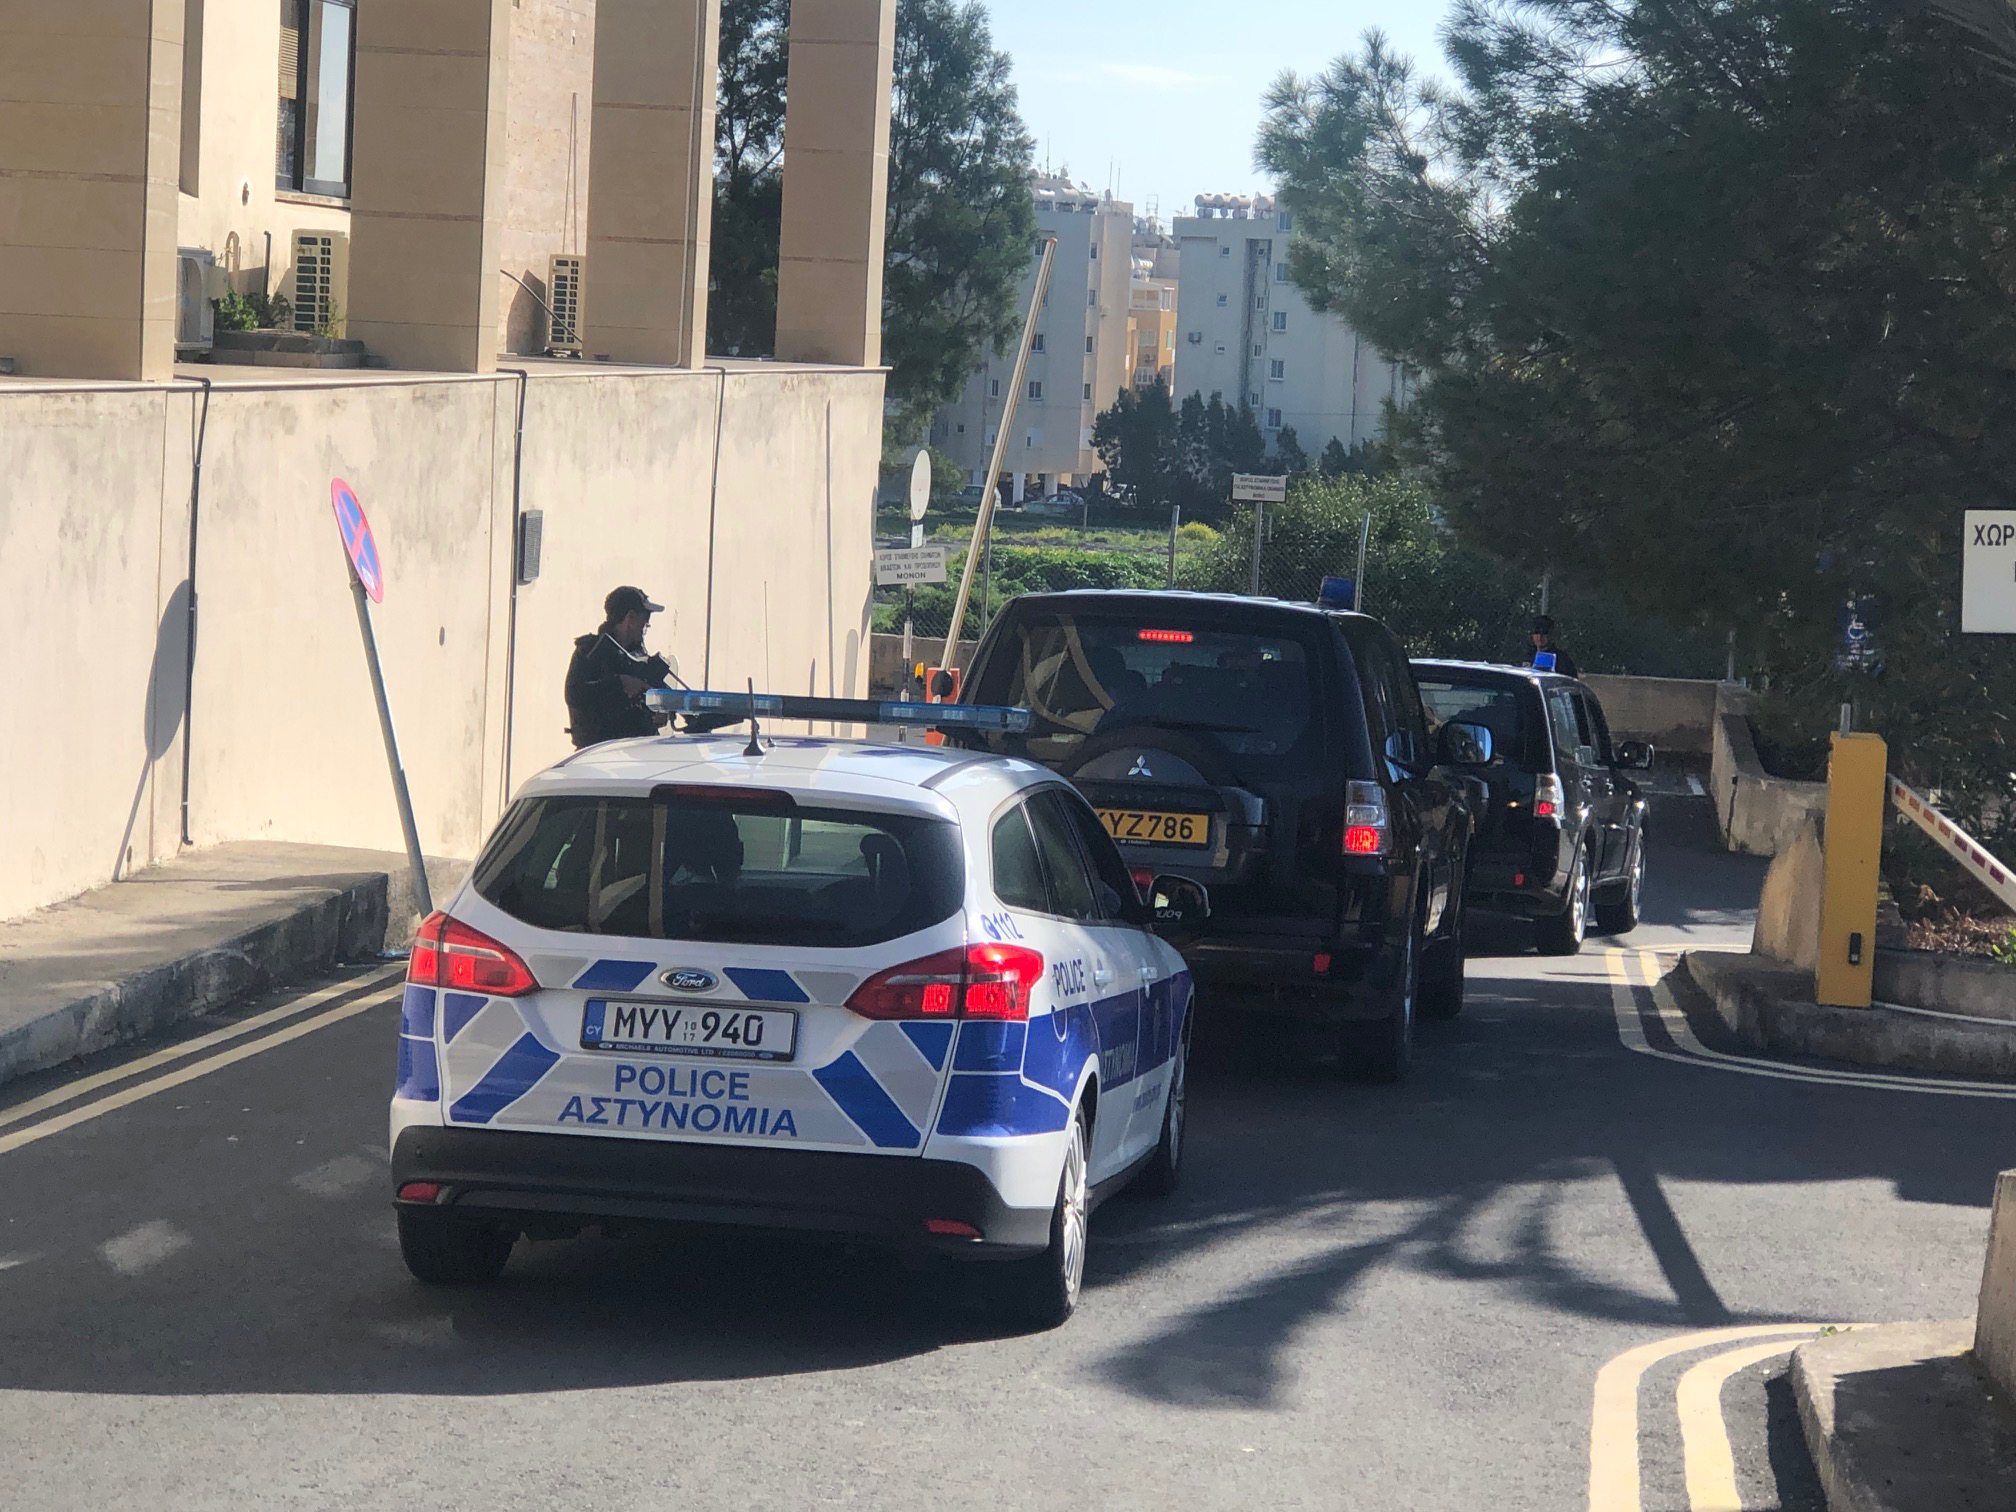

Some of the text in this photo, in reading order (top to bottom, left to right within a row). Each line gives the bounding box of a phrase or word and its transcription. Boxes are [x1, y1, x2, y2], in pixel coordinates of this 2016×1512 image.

[1973, 523, 2016, 546] ΧΩΡ
[1099, 811, 1194, 840] YZ786
[672, 972, 706, 988] Ford
[1052, 958, 1087, 998] POLICE
[586, 1025, 602, 1036] CY
[613, 1006, 765, 1046] MYY 940
[682, 1032, 696, 1042] 17
[684, 1020, 697, 1031] 10
[700, 1048, 714, 1056] LTD
[614, 1064, 750, 1101] POLICE
[558, 1095, 798, 1137] ΑΣΤΥΝΟΜΙΑ
